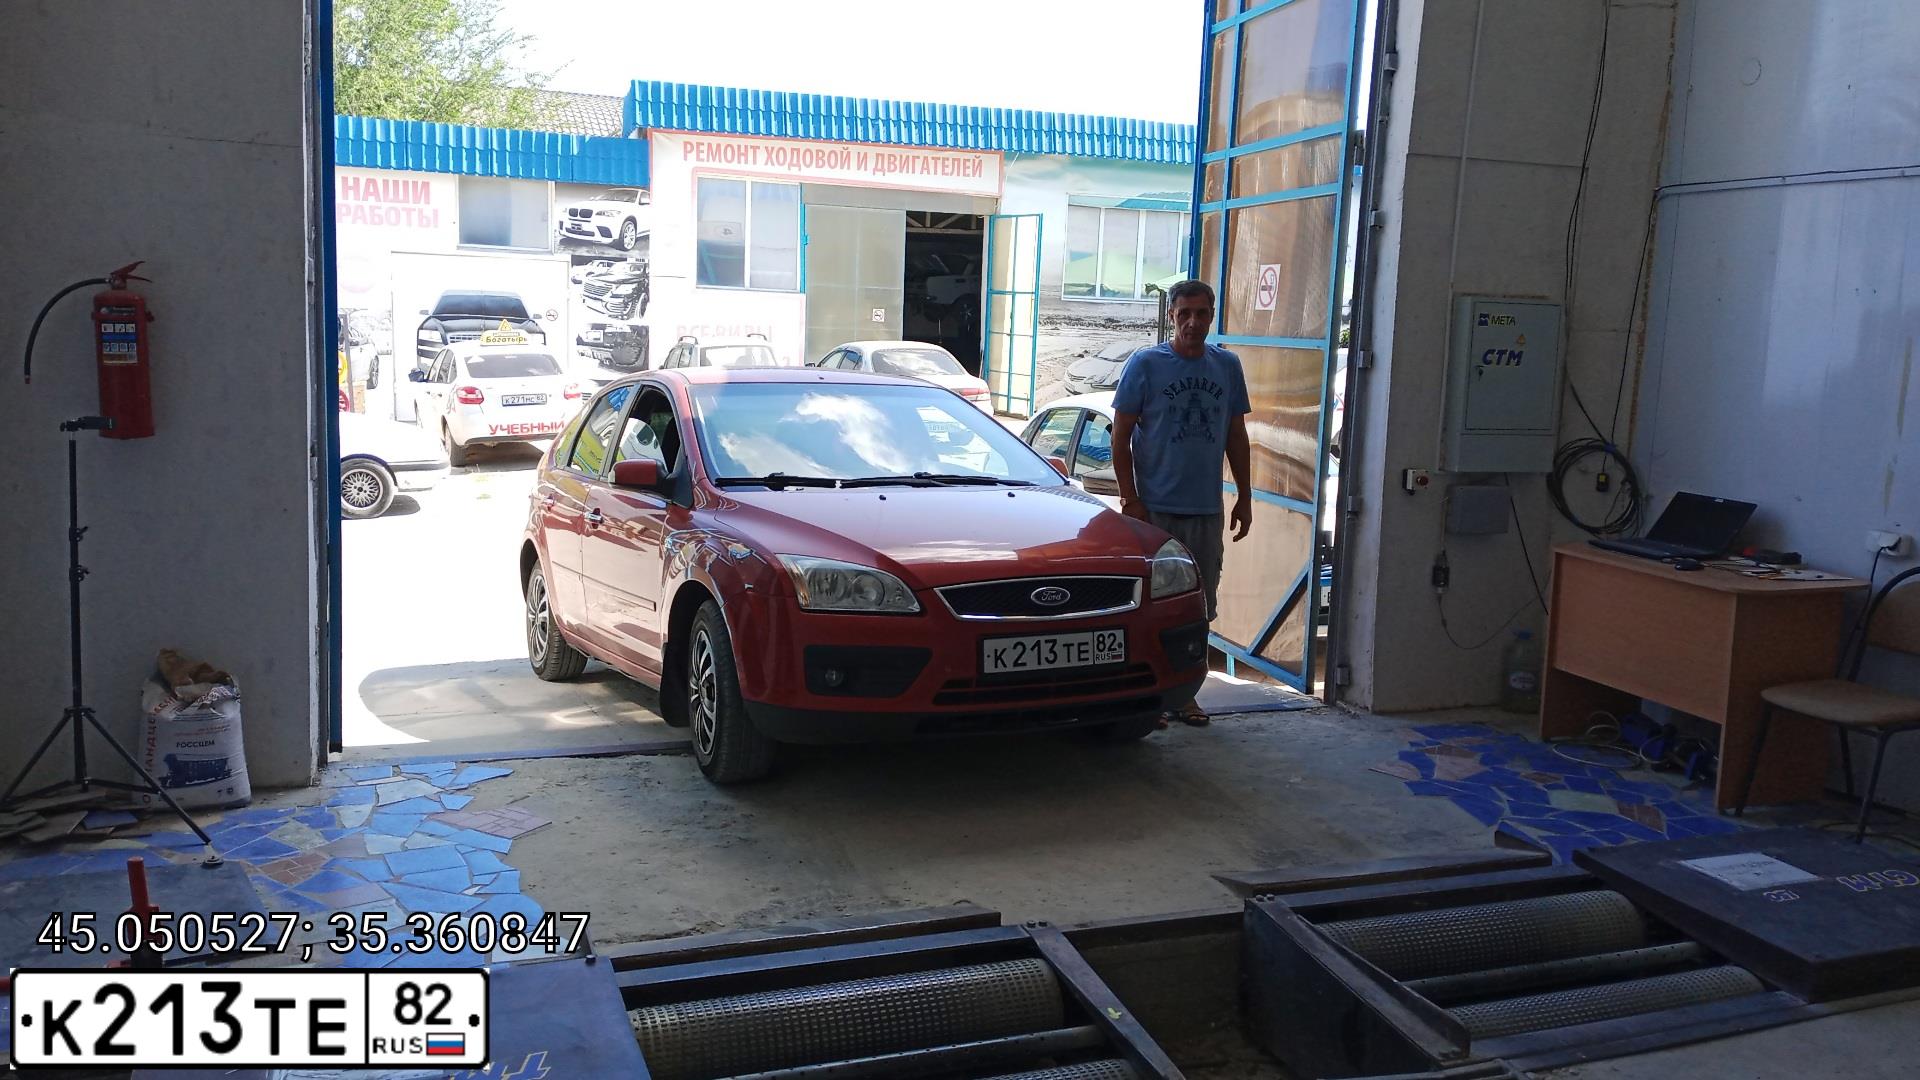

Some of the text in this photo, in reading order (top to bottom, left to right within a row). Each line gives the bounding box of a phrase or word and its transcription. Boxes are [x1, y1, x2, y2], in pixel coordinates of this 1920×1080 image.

[683, 141, 983, 178] РЕМОНТ ХОДОВОЙ И ДВИГАТЕЛЕЙ
[341, 176, 430, 205] НАШИ
[336, 203, 439, 228] РАБОТЫ
[1163, 377, 1223, 400] SEAFARER
[1096, 633, 1117, 652] 82
[1096, 653, 1111, 661] RUS
